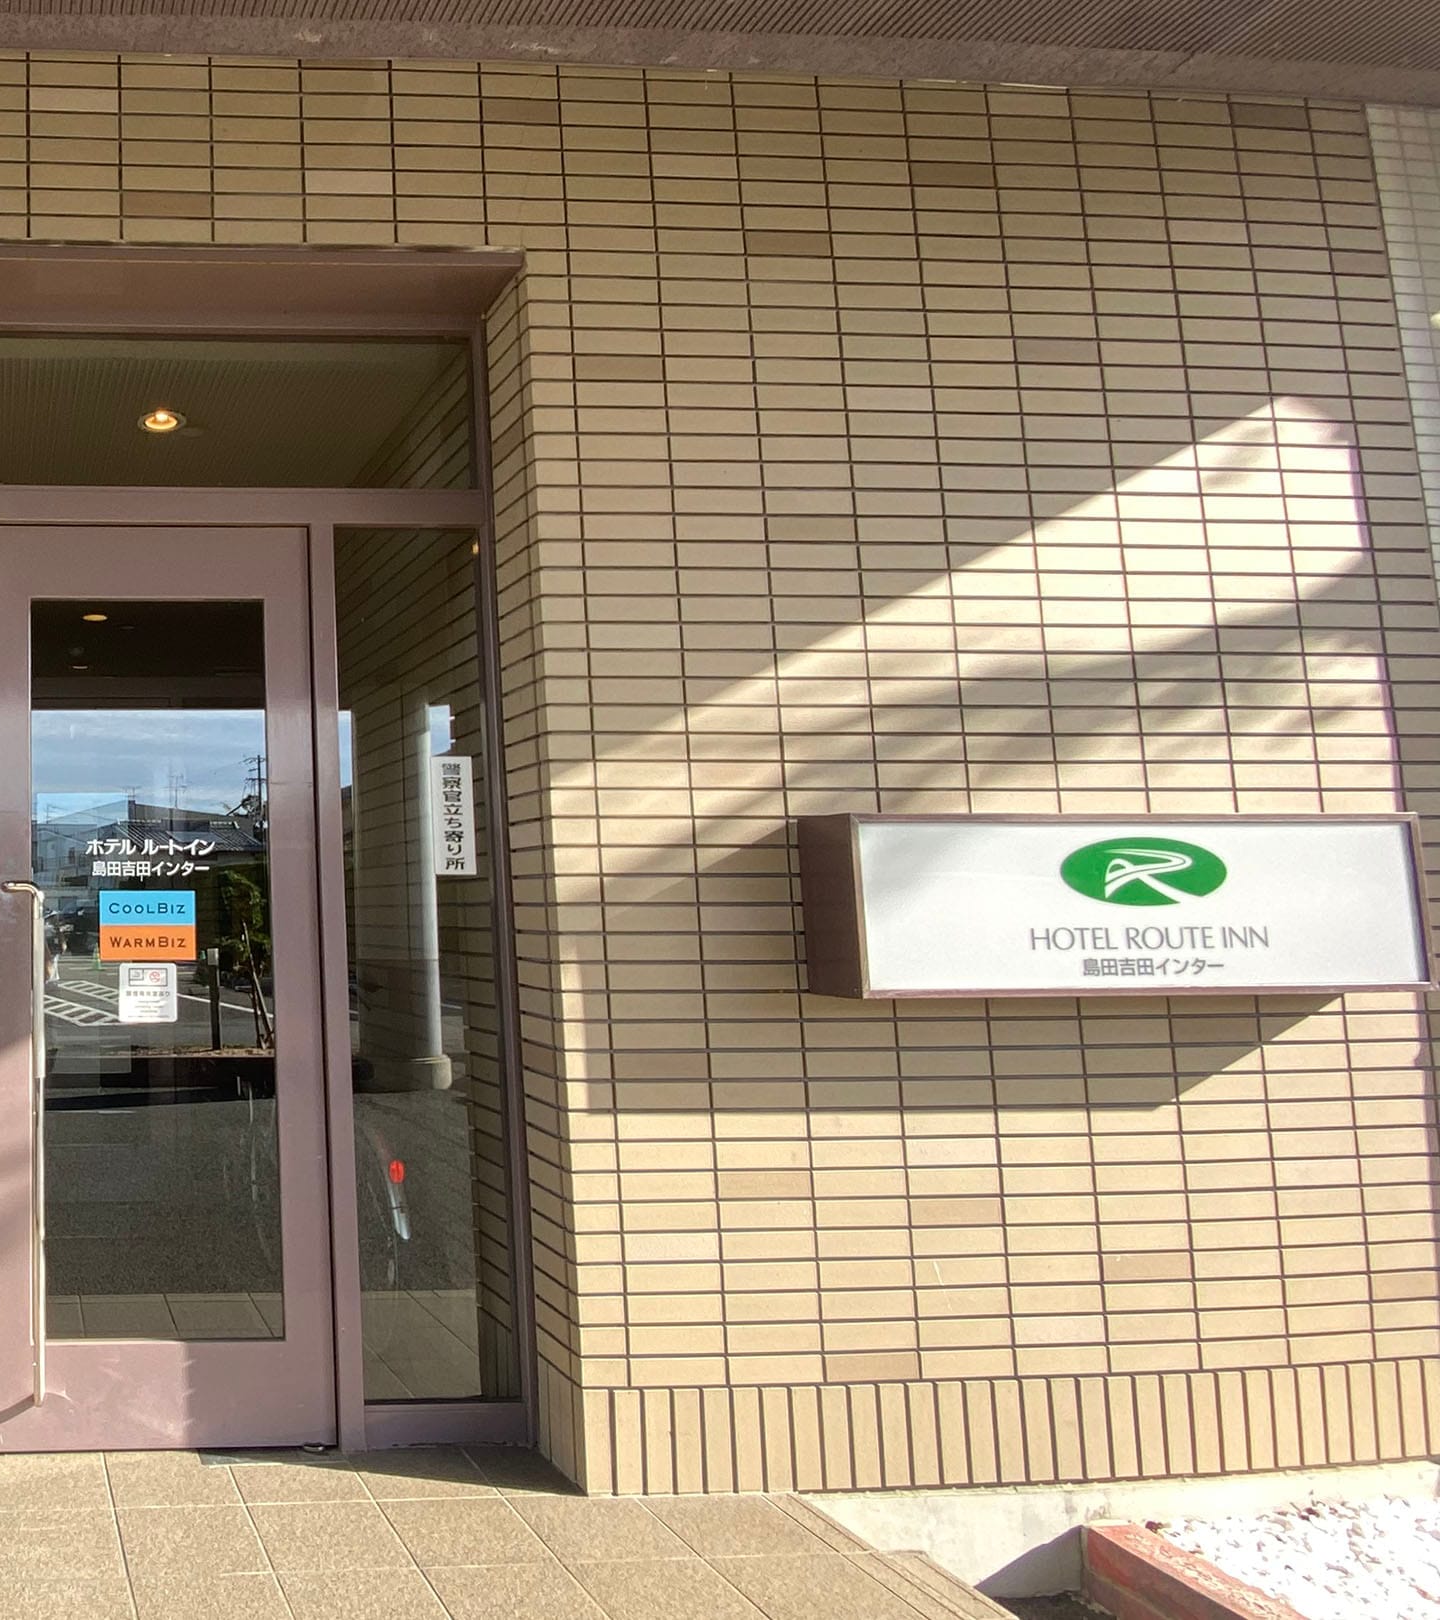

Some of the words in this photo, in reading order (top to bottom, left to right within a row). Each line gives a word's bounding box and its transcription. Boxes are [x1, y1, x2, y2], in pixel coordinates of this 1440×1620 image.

[441, 763, 465, 871] 警察官立ち寄り所
[85, 839, 136, 856] ホテル
[141, 839, 216, 856] ルートイン
[92, 861, 210, 877] 島田吉田インター
[1029, 926, 1119, 951] HOTEL
[1125, 926, 1216, 950] ROUTE
[1222, 925, 1269, 949] INN
[1082, 957, 1225, 978] 島田吉田インター
